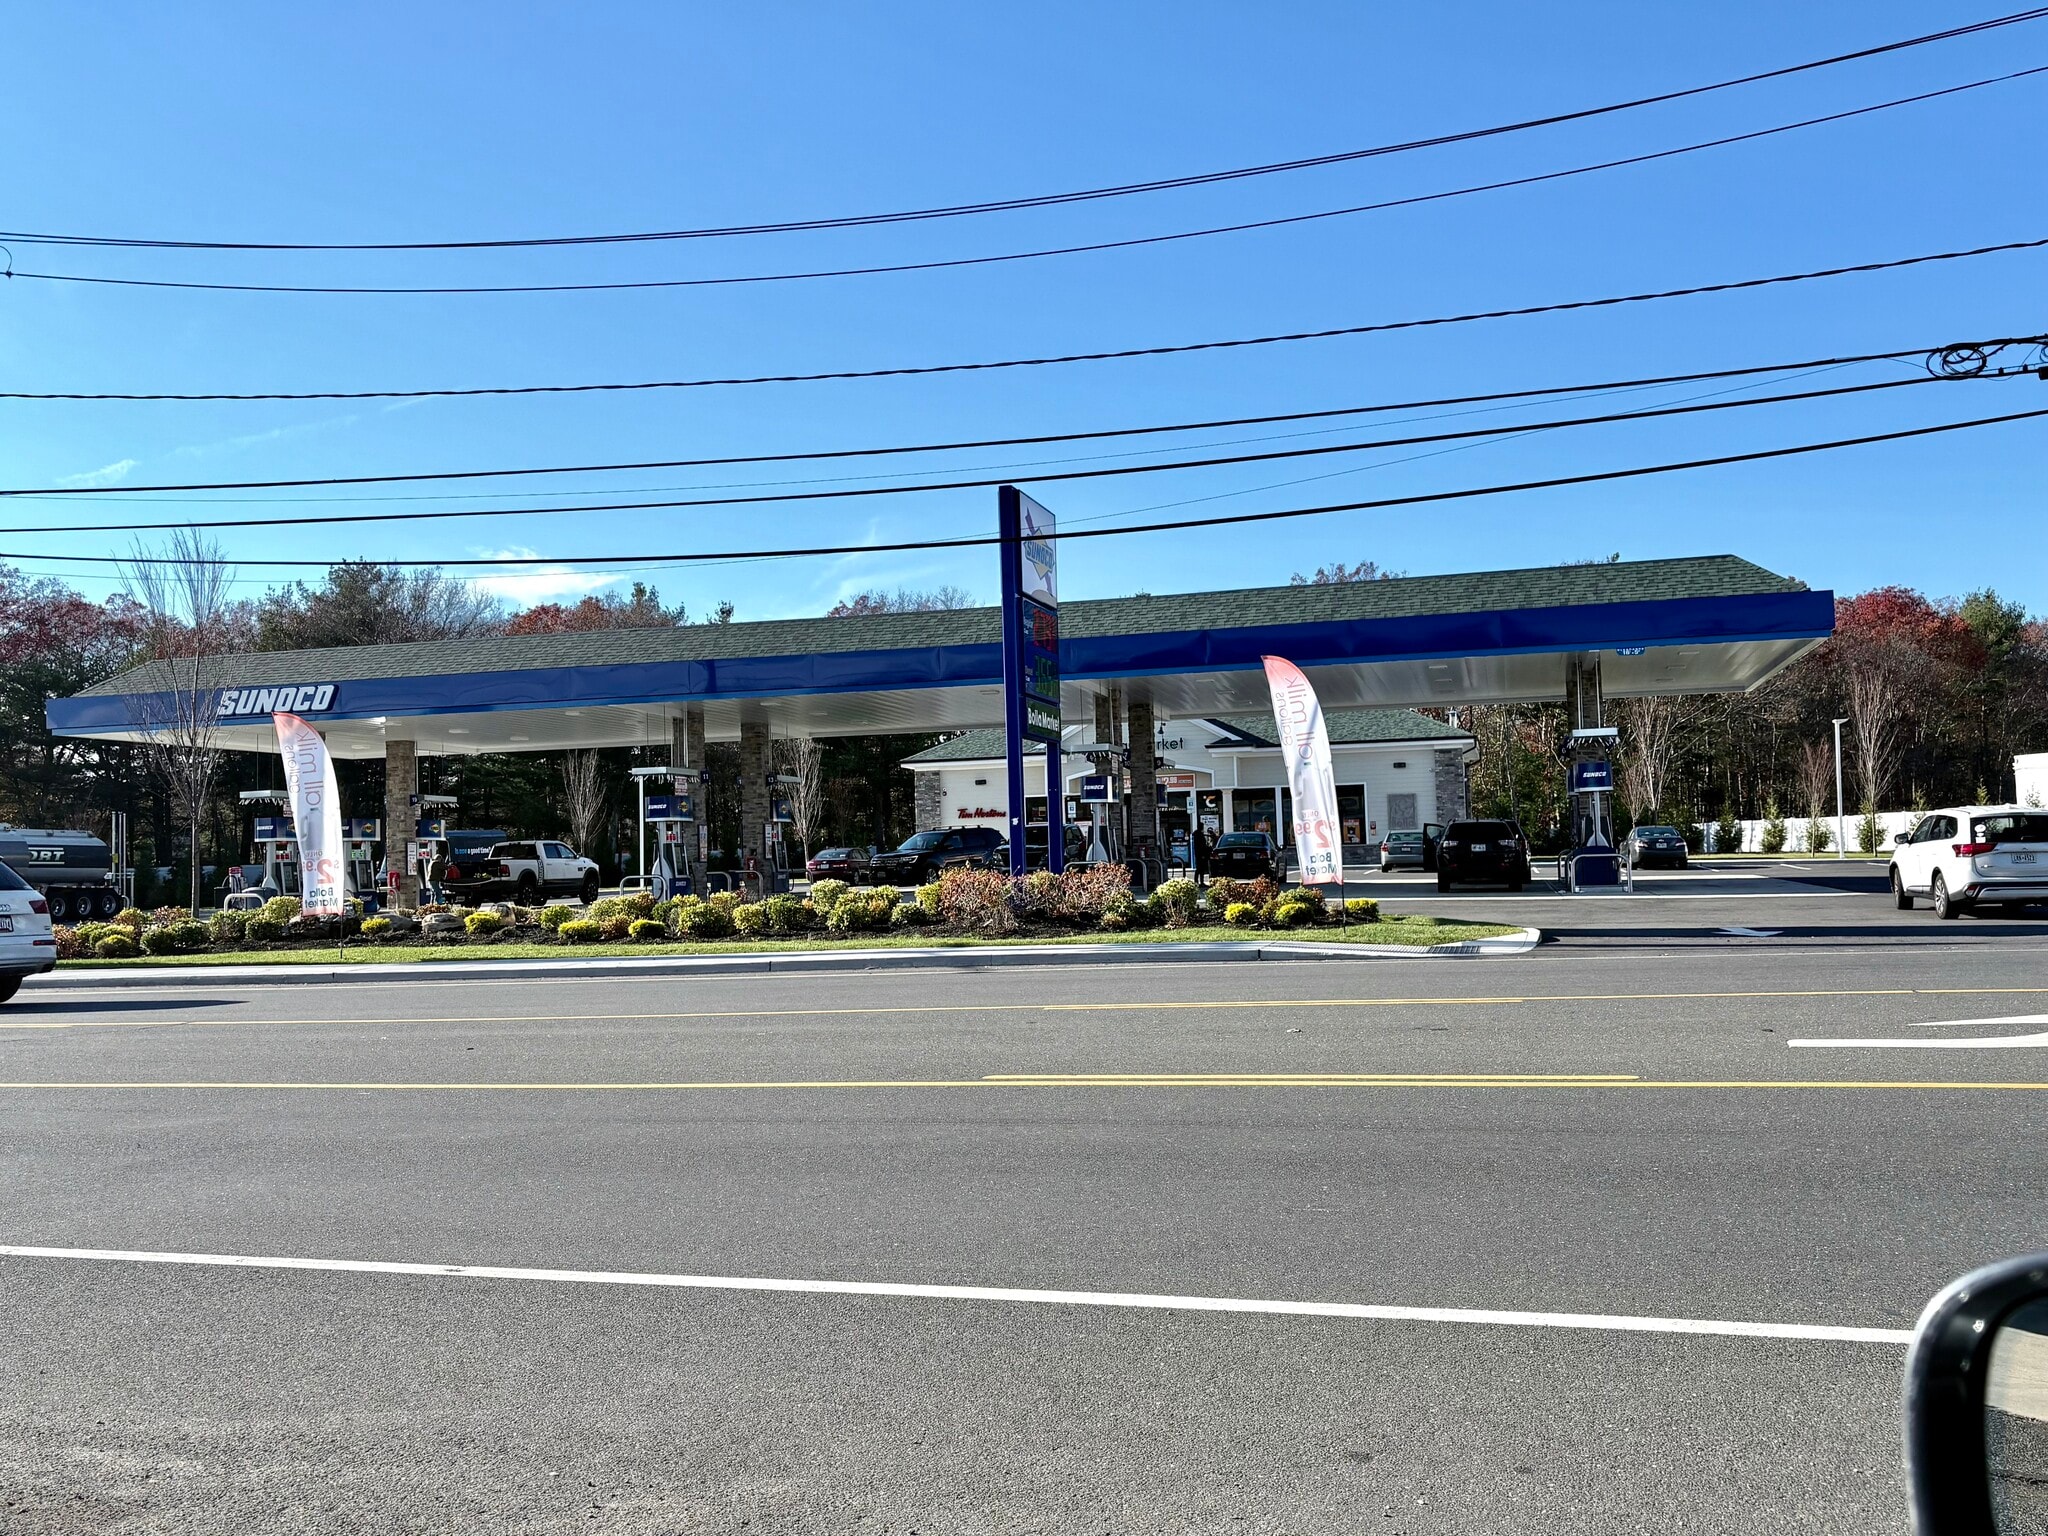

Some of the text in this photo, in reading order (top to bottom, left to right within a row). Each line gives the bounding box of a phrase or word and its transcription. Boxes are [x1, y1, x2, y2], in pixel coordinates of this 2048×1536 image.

[1026, 540, 1054, 571] SUNOCO
[219, 684, 336, 716] SUNOCO
[1027, 707, 1042, 728] Bolla
[1156, 737, 1184, 750] rket
[957, 807, 1006, 819] Tim Hortons
